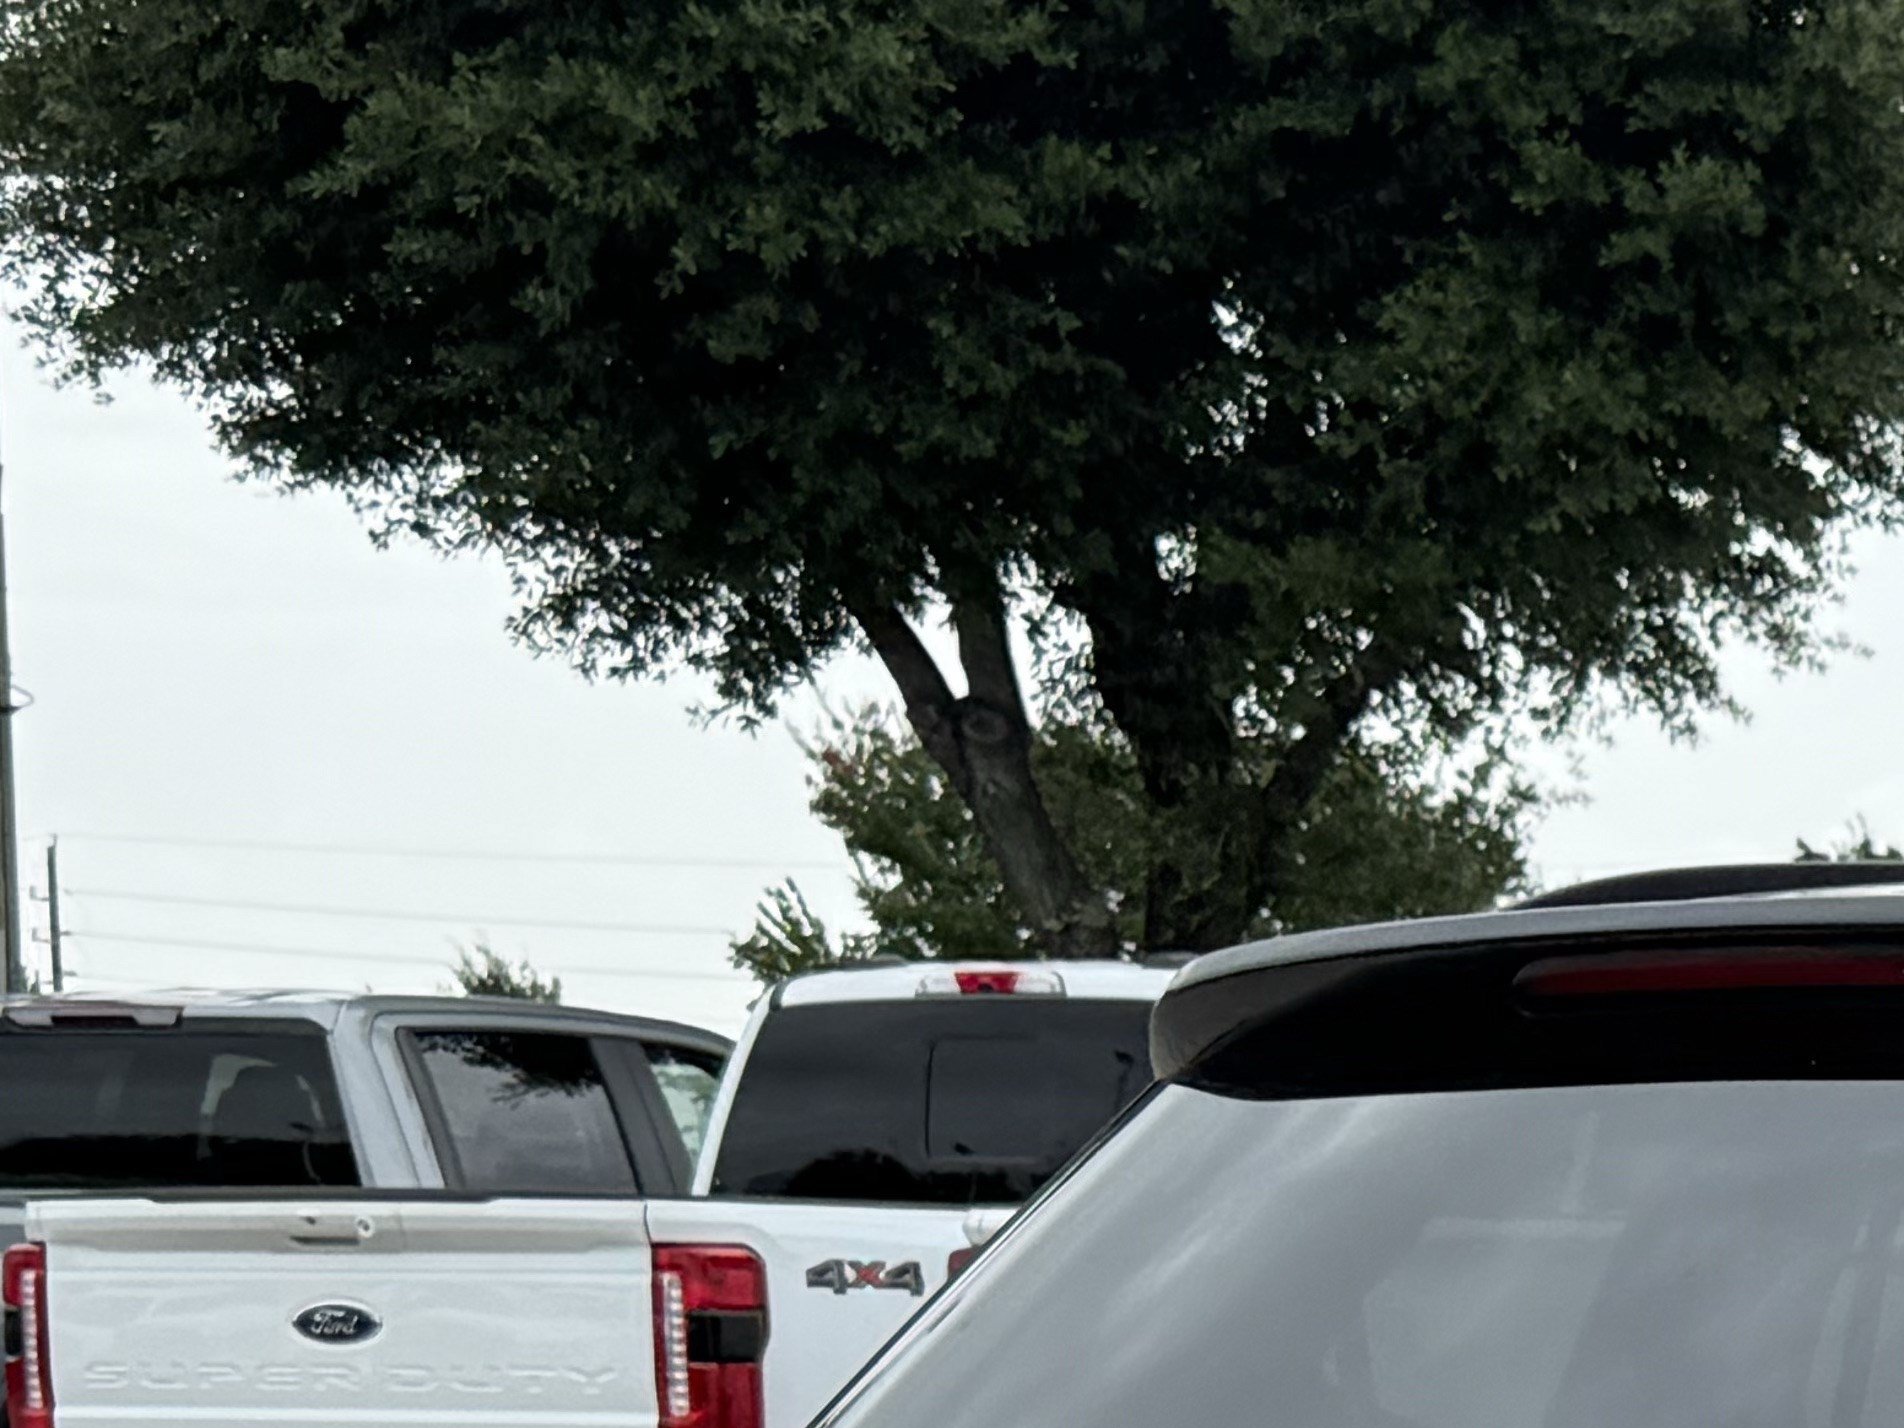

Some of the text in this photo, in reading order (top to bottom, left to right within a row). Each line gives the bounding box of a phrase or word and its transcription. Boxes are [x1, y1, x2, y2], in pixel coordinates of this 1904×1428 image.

[311, 1308, 358, 1335] Ford
[84, 1361, 618, 1394] SUPER DUTY
